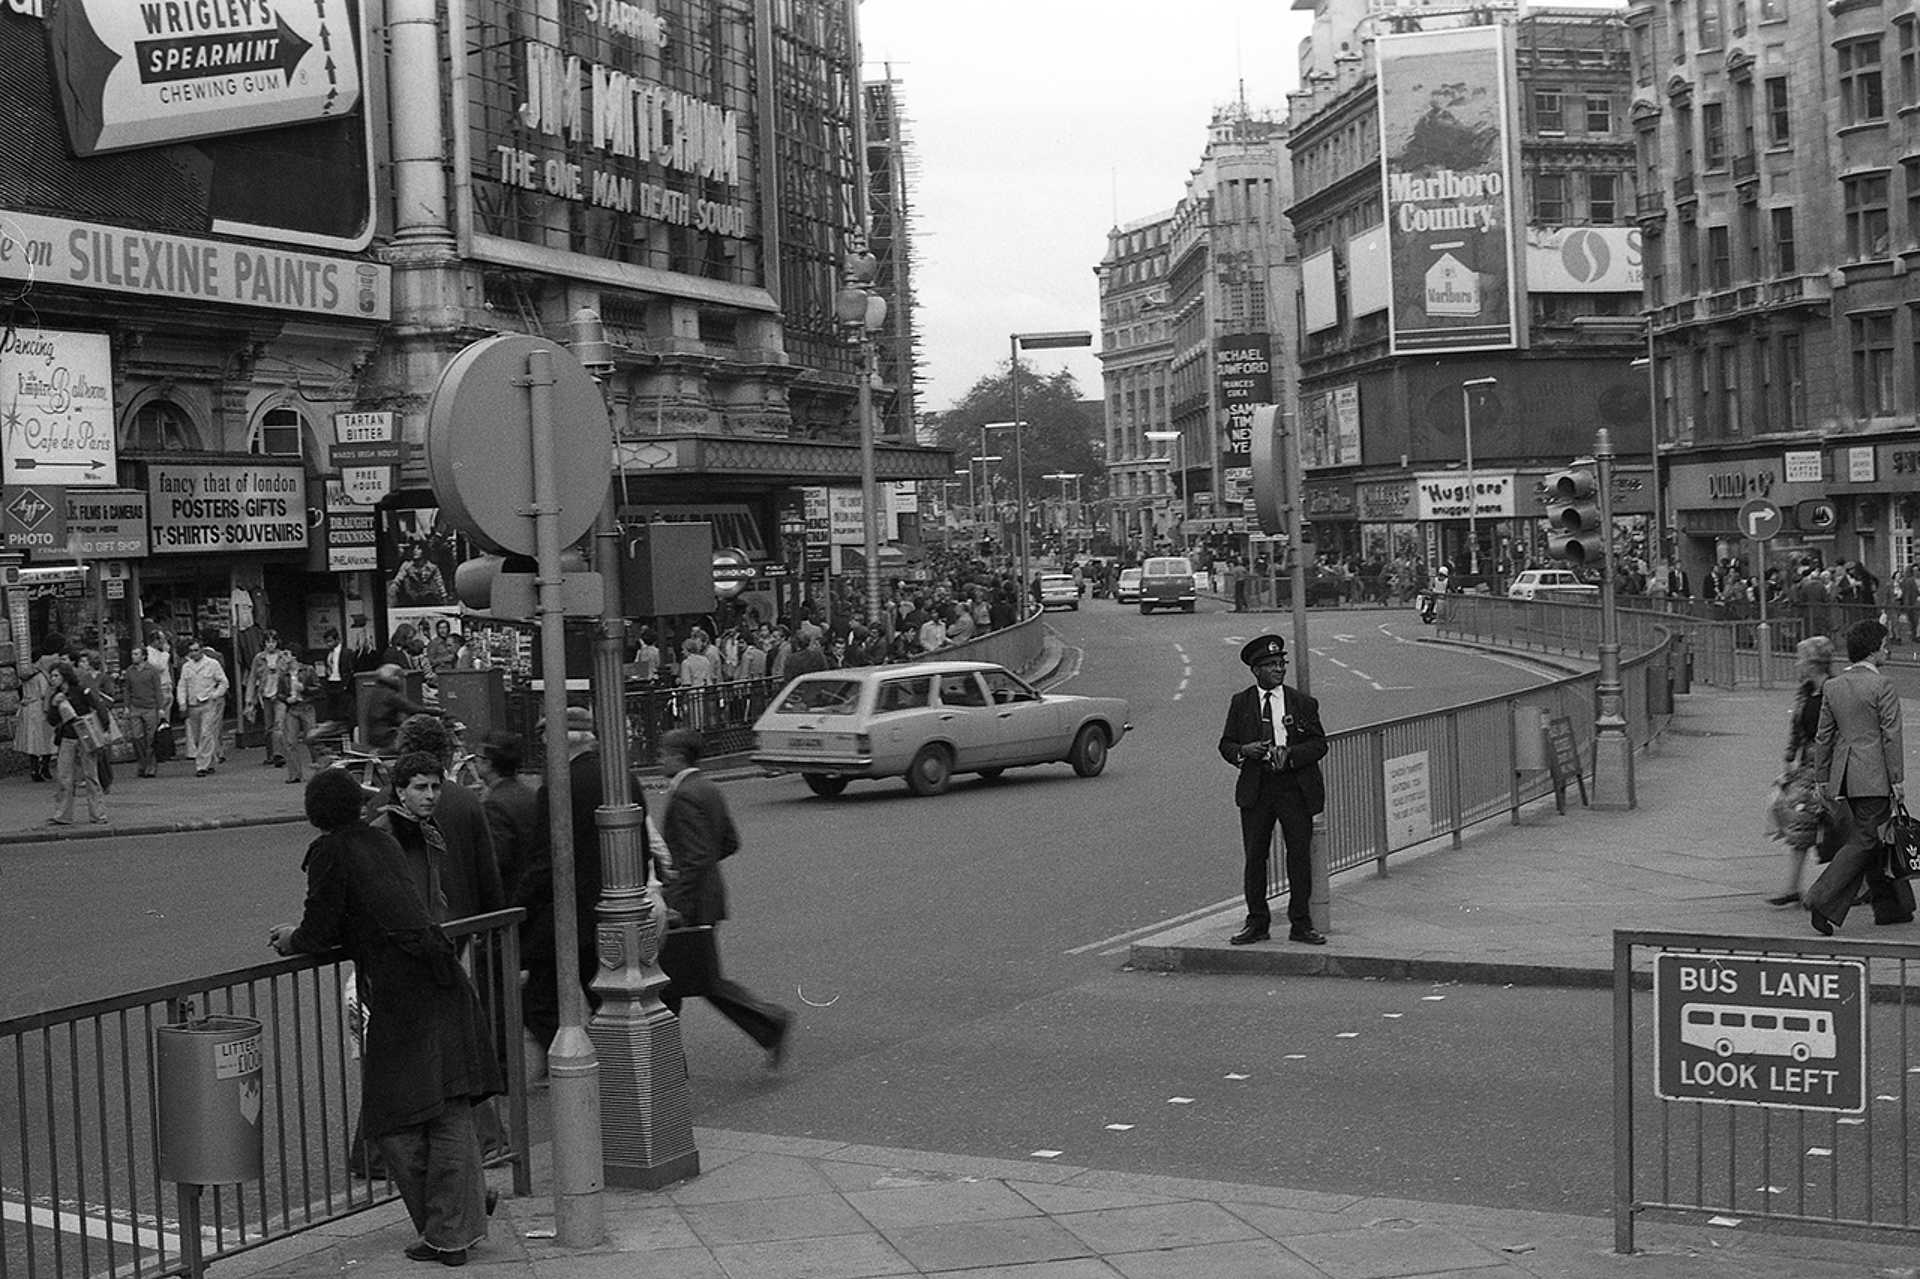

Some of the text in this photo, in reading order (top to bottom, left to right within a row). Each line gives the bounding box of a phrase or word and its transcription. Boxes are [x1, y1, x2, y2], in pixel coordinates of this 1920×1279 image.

[150, 38, 280, 73] SPEARMINT
[160, 74, 280, 104] CHEWING GUM
[519, 42, 740, 187] JIM MITCHUM
[498, 145, 537, 190] THE
[546, 160, 584, 200] ONE
[592, 171, 633, 213] MAN
[640, 183, 690, 227] DEATH
[1391, 169, 1502, 202] Marlboro
[25, 240, 53, 266] on
[68, 228, 219, 297] SILEXINE
[234, 252, 339, 310] PAINTS
[3, 329, 55, 366] Dancing
[344, 413, 384, 427] TARTAN
[347, 428, 383, 440] BITTER
[159, 471, 297, 497] fancy that of london
[8, 533, 54, 545] PHOTO
[328, 530, 376, 543] GUINNESS
[329, 516, 375, 530] DRAUGHT
[1680, 966, 1840, 1000] BUS LANE
[1680, 1060, 1840, 1095] LOOK LEFT
